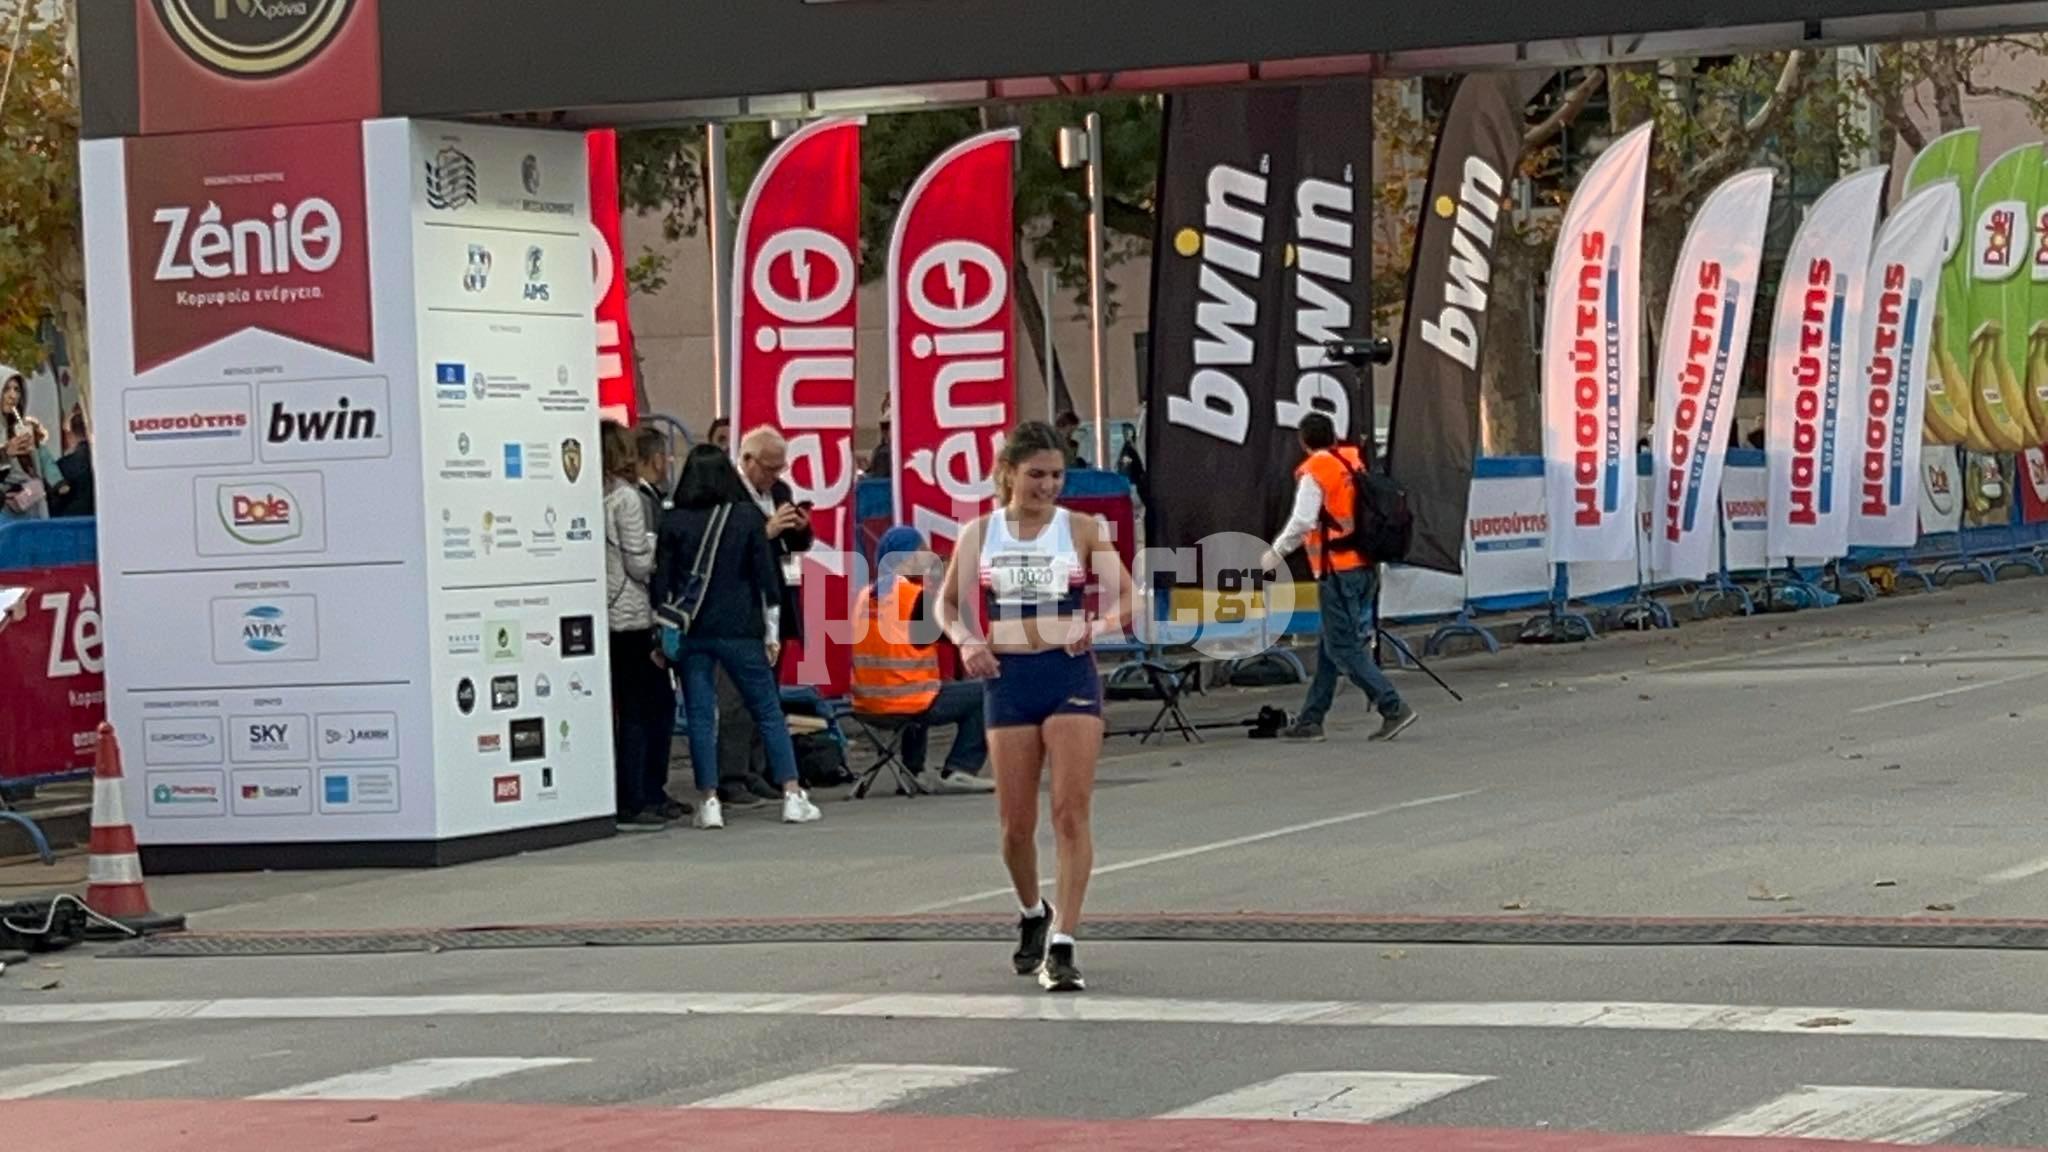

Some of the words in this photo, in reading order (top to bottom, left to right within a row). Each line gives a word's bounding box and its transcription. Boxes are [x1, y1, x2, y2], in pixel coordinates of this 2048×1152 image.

[1420, 155, 1503, 371] bwin
[1983, 209, 2009, 266] Dole
[1167, 164, 1268, 445] bwin
[1275, 178, 1353, 440] bwin
[1607, 321, 1620, 396] MARKET
[267, 396, 376, 443] bwin
[1607, 409, 1620, 466] SUPER
[232, 493, 289, 521] Dole
[1009, 568, 1053, 585] 10020
[250, 724, 288, 742] SKY
